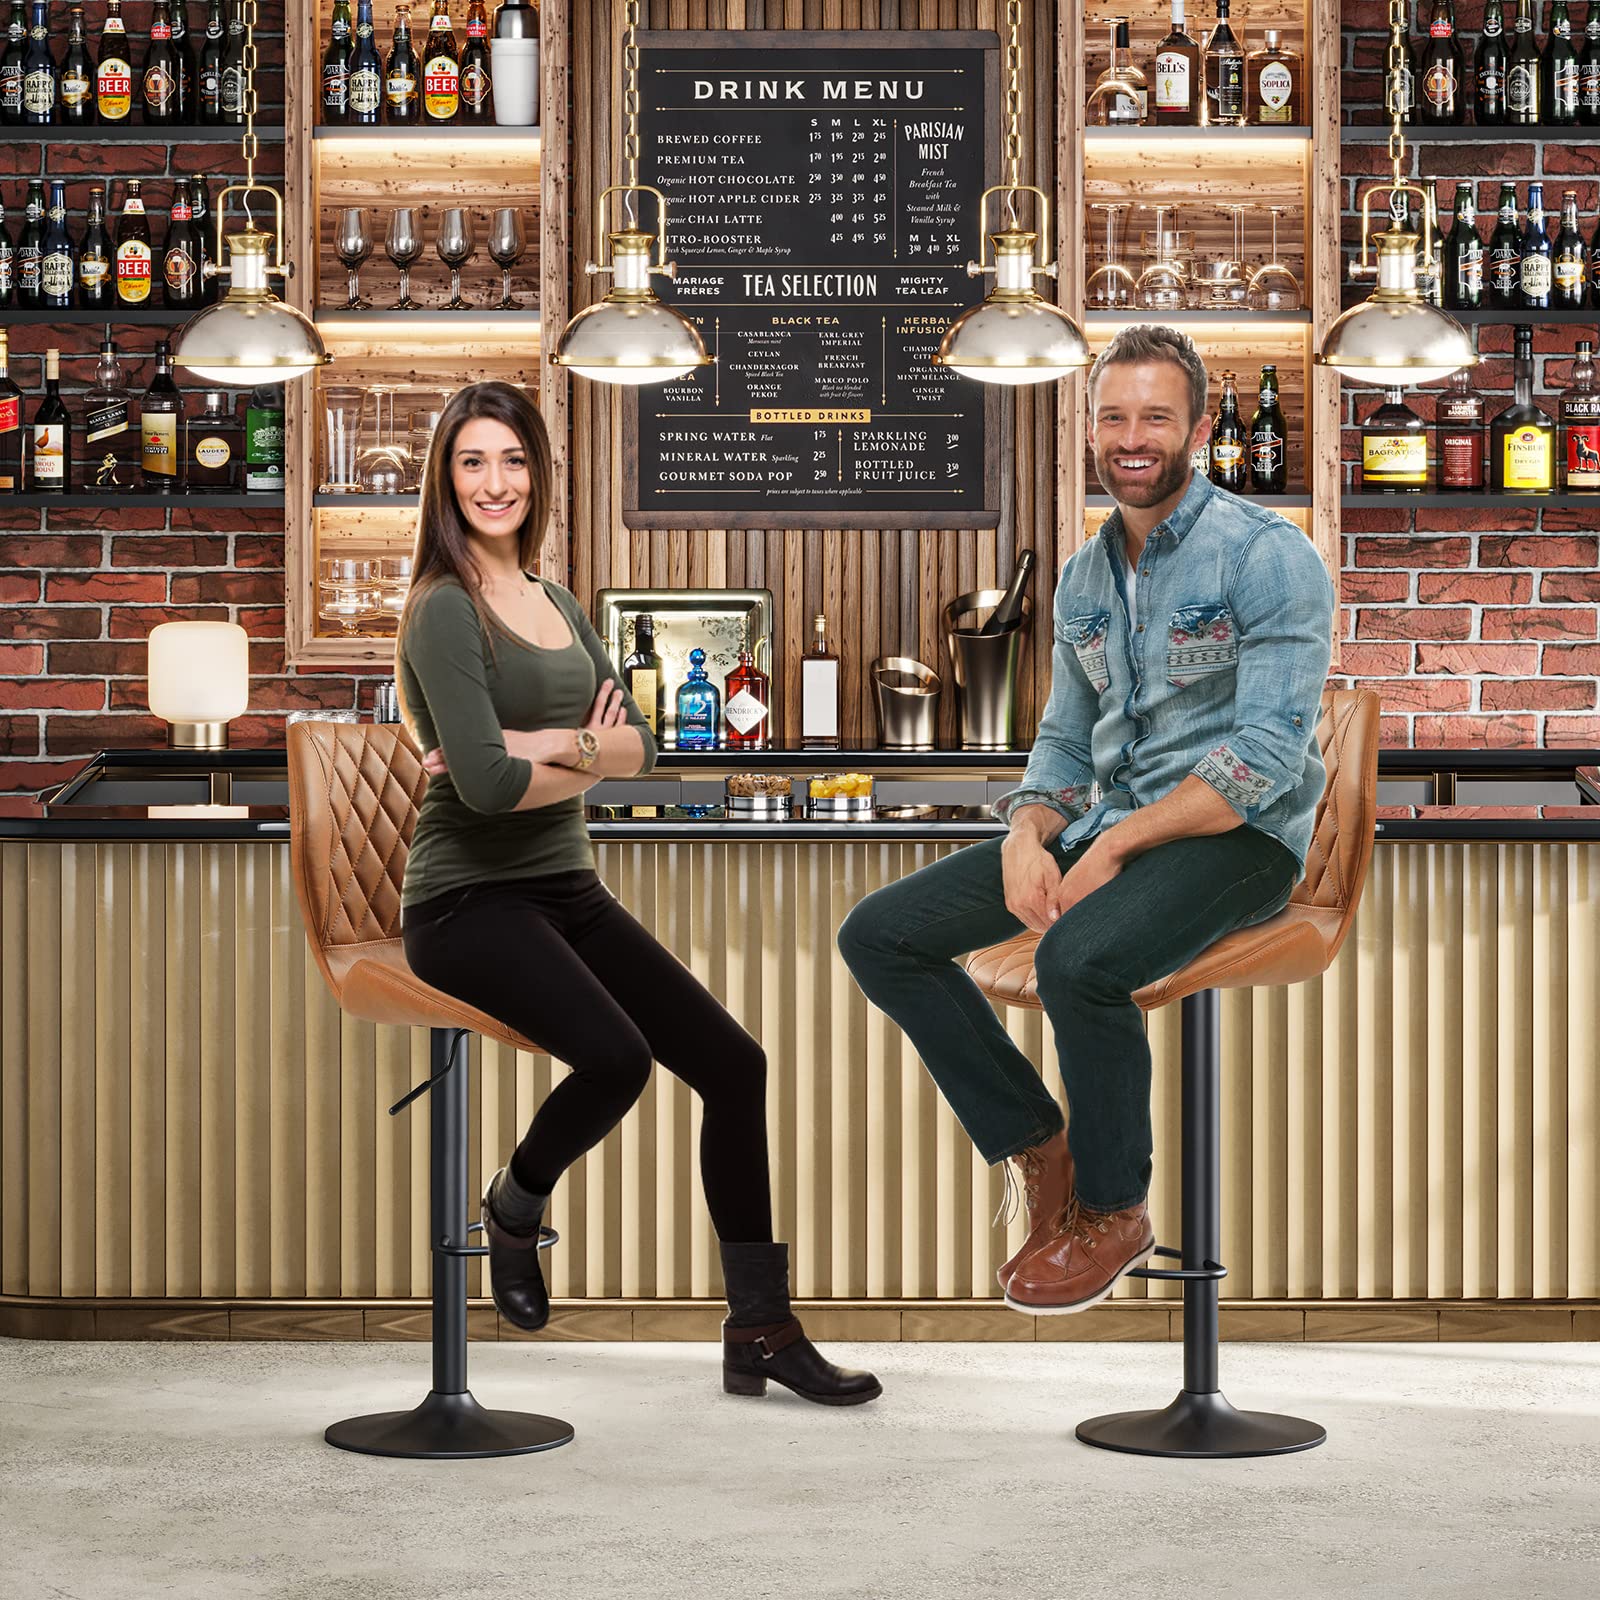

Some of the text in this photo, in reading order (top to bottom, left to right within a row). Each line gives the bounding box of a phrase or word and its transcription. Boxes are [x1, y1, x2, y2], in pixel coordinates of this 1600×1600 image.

[1156, 62, 1186, 73] BELL'S
[100, 80, 130, 93] BEER
[352, 79, 377, 87] HAPPY
[426, 78, 458, 92] BEER
[1262, 80, 1290, 88] SOPLICA
[694, 80, 924, 100] DRINK MENU
[811, 119, 887, 127] S M L XL
[904, 122, 964, 141] PARISIAN
[658, 135, 709, 144] BREWED
[713, 135, 762, 144] COFFEE
[919, 144, 949, 160] MIST
[658, 156, 717, 164] PREMIUM
[721, 156, 745, 164] TEA
[921, 168, 945, 176] French
[658, 176, 687, 186] Organic
[688, 176, 715, 184] HOT
[718, 176, 796, 184] CHOCOLATE
[909, 180, 957, 190] Breakfast Tea
[658, 196, 687, 206] rganic
[688, 195, 715, 204] HOT
[718, 195, 757, 204] APPLE
[761, 195, 800, 204] CIDER
[926, 192, 940, 200] with
[906, 204, 961, 212] Steamed Milk &
[688, 216, 719, 224] CHAI
[724, 216, 763, 224] LATTE
[911, 216, 956, 226] Vanilla Syrup
[910, 234, 960, 242] M L XL
[1496, 250, 1513, 259] DARK
[118, 262, 150, 275] BEER
[743, 274, 877, 297] TEA SELECTION
[677, 286, 720, 295] FRÈRES
[772, 317, 840, 325] BLACK TEA
[904, 317, 952, 325] HERBAL
[897, 326, 948, 334] INFUSIO
[1566, 403, 1589, 413] BLACK
[89, 410, 126, 425] BLACK LABEL
[756, 412, 865, 420] BOTTLED DRINKS
[660, 432, 708, 441] SPRING
[713, 432, 756, 441] WATER
[854, 431, 927, 440] SPARKLING
[854, 442, 926, 451] LEMONADE
[660, 452, 719, 461] MINERAL
[724, 452, 767, 461] WATER
[771, 454, 799, 463] Sparkling
[856, 460, 914, 469] BOTTLED
[660, 472, 725, 481] GOURMET
[729, 472, 763, 481] SODA
[768, 472, 793, 481] POP
[856, 471, 936, 482] FRUIT JUICE
[684, 699, 707, 716] 12
[727, 707, 764, 715] HENDRICK'S
